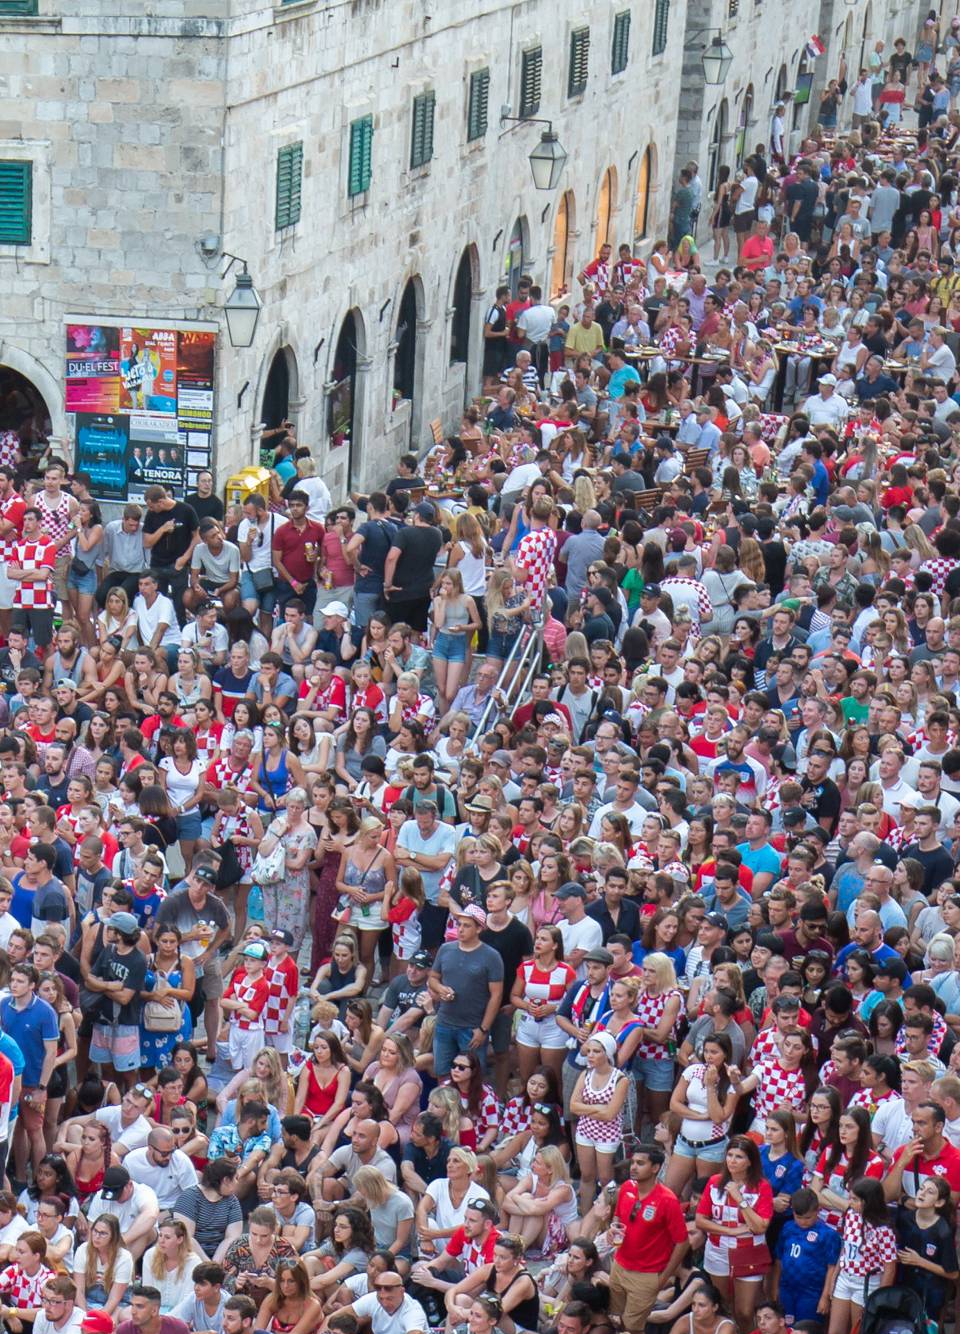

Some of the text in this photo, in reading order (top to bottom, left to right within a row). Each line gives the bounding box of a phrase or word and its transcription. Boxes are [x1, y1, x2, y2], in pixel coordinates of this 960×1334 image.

[97, 361, 119, 372] FEST
[134, 468, 141, 476] 4
[142, 468, 182, 480] TENORA
[790, 1243, 801, 1258] 10
